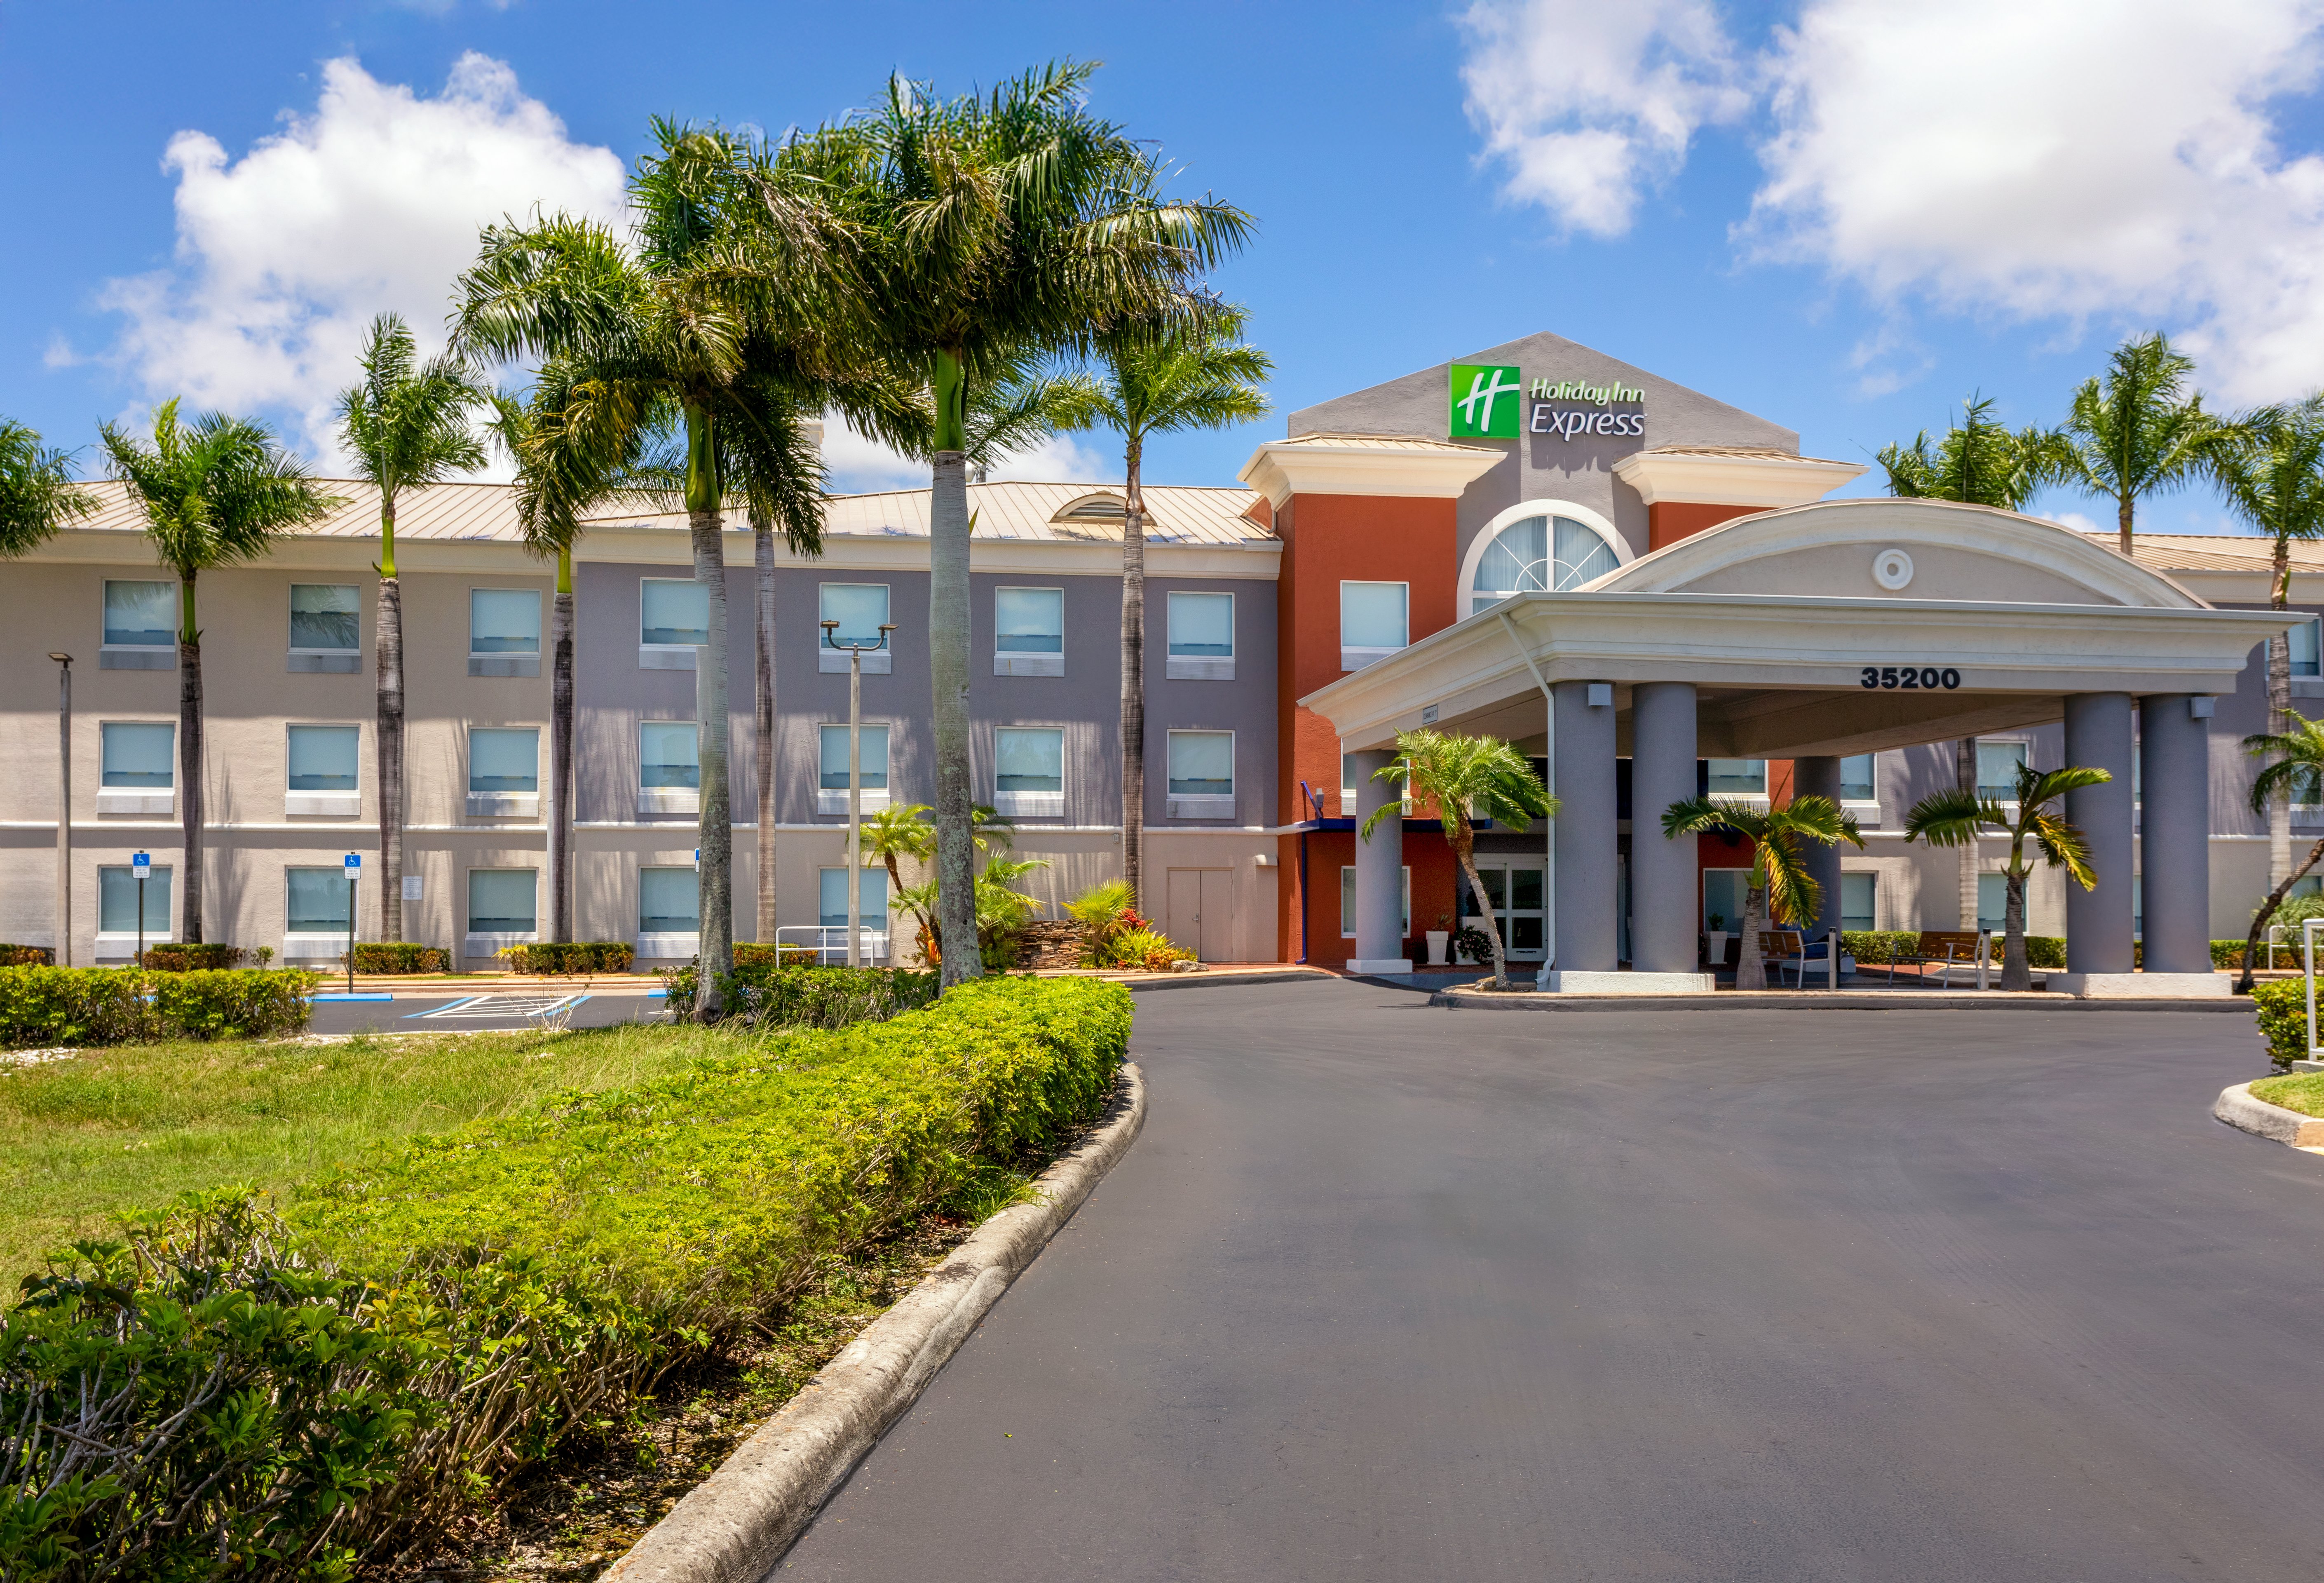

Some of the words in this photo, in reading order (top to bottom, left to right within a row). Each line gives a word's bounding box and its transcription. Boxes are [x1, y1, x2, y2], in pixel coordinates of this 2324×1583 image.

[1529, 378, 1610, 406] Holiday
[1612, 381, 1645, 402] Inn
[1530, 404, 1644, 442] Express
[1861, 667, 1961, 689] 35200
